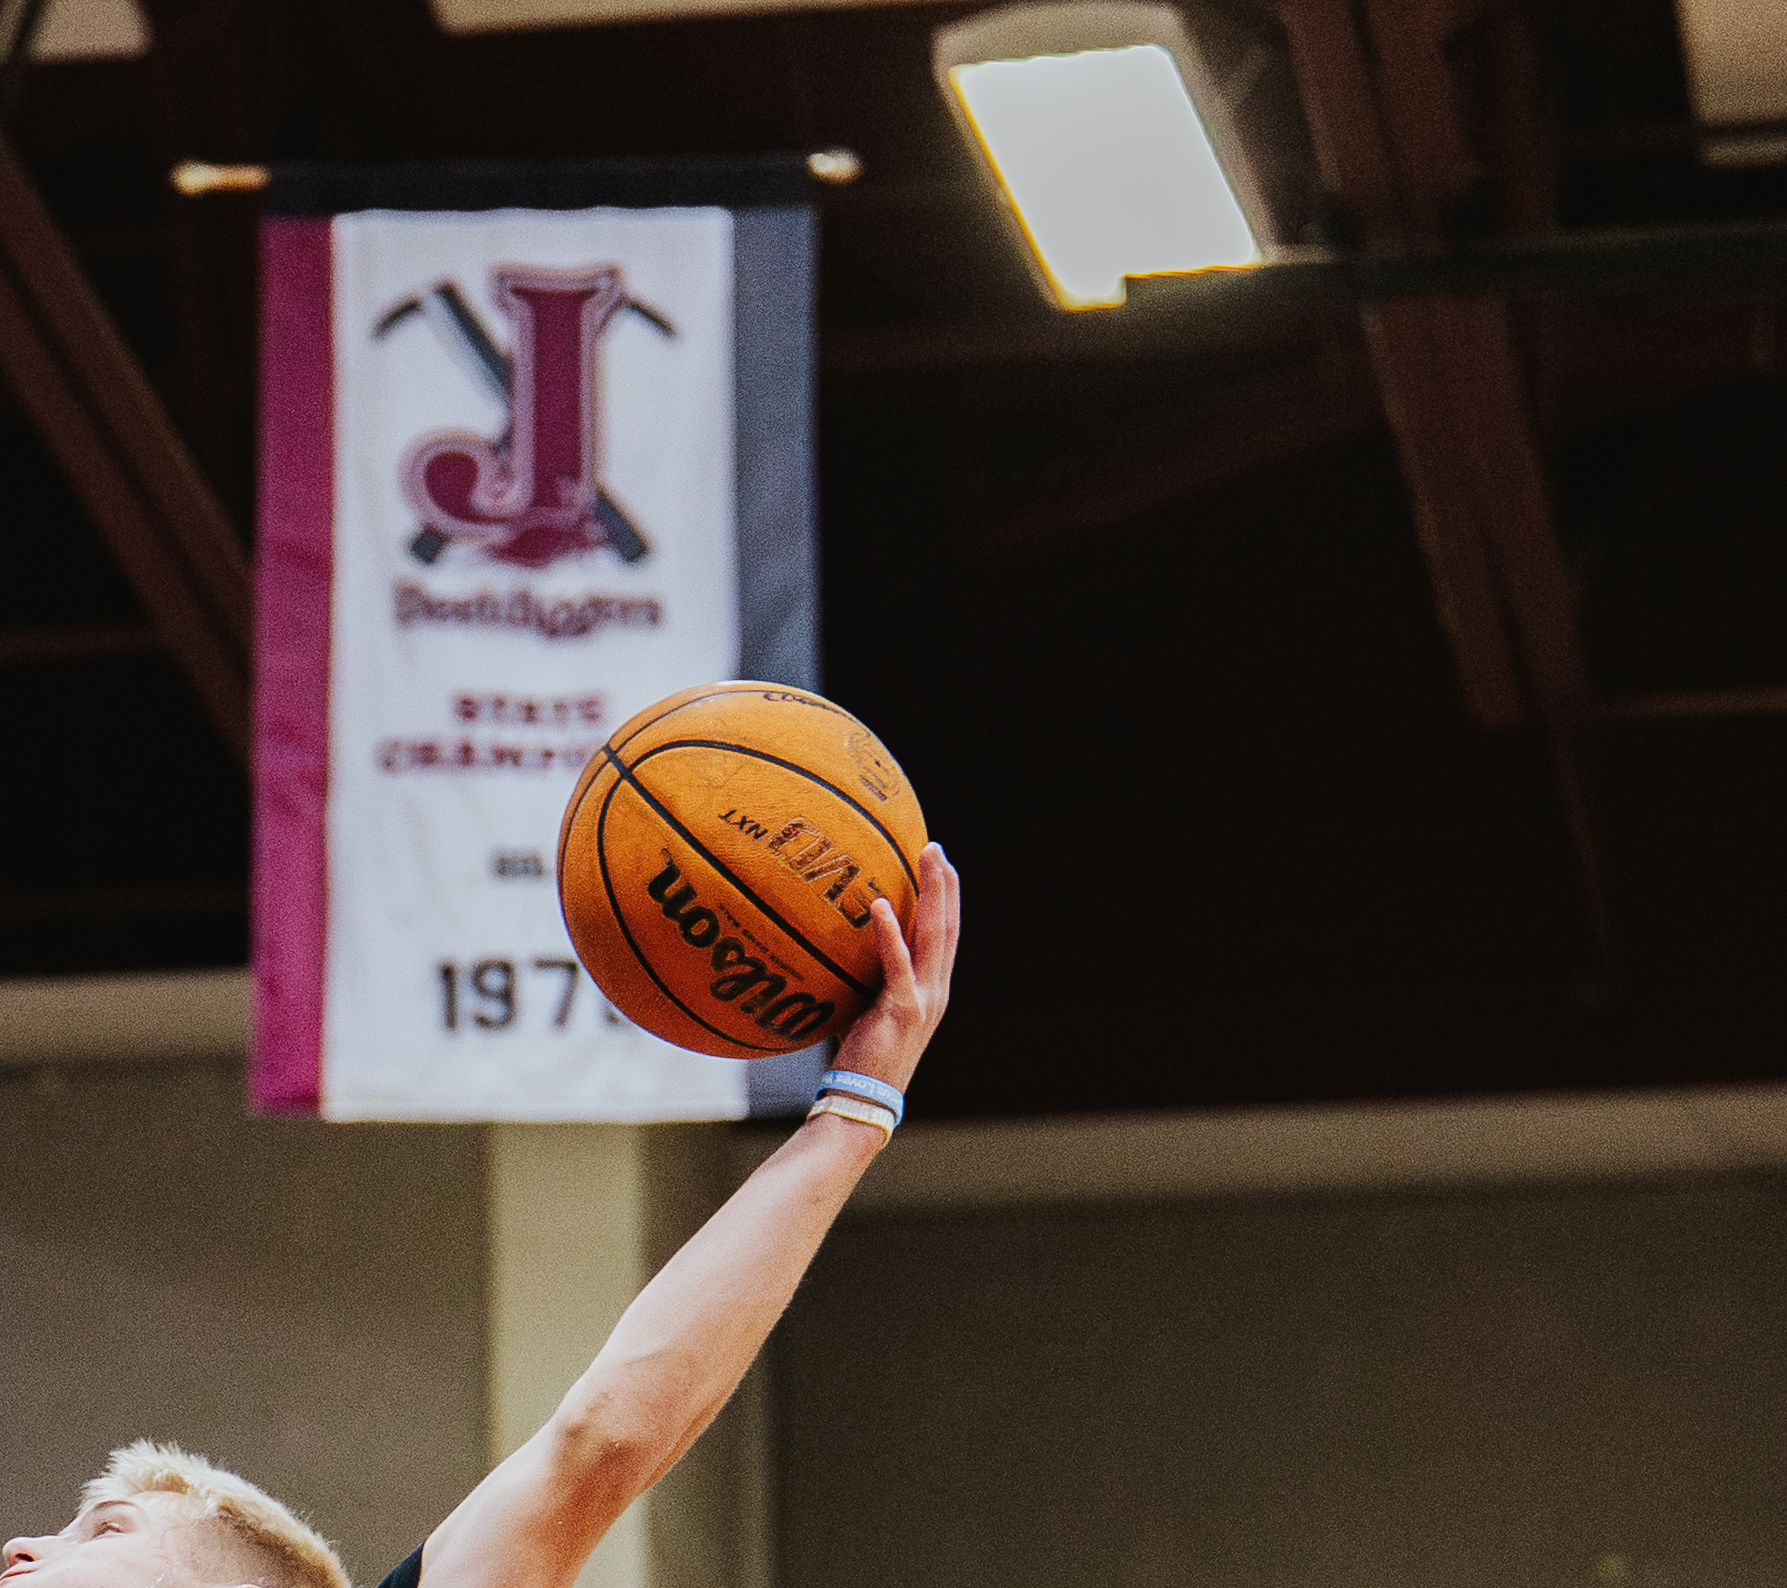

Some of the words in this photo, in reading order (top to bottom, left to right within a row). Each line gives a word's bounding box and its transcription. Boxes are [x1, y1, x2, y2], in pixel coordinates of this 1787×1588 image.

[376, 740, 595, 775] CHAMPI
[718, 808, 768, 841] NXT
[646, 848, 835, 1041] Wilson
[435, 956, 625, 1032] 197
